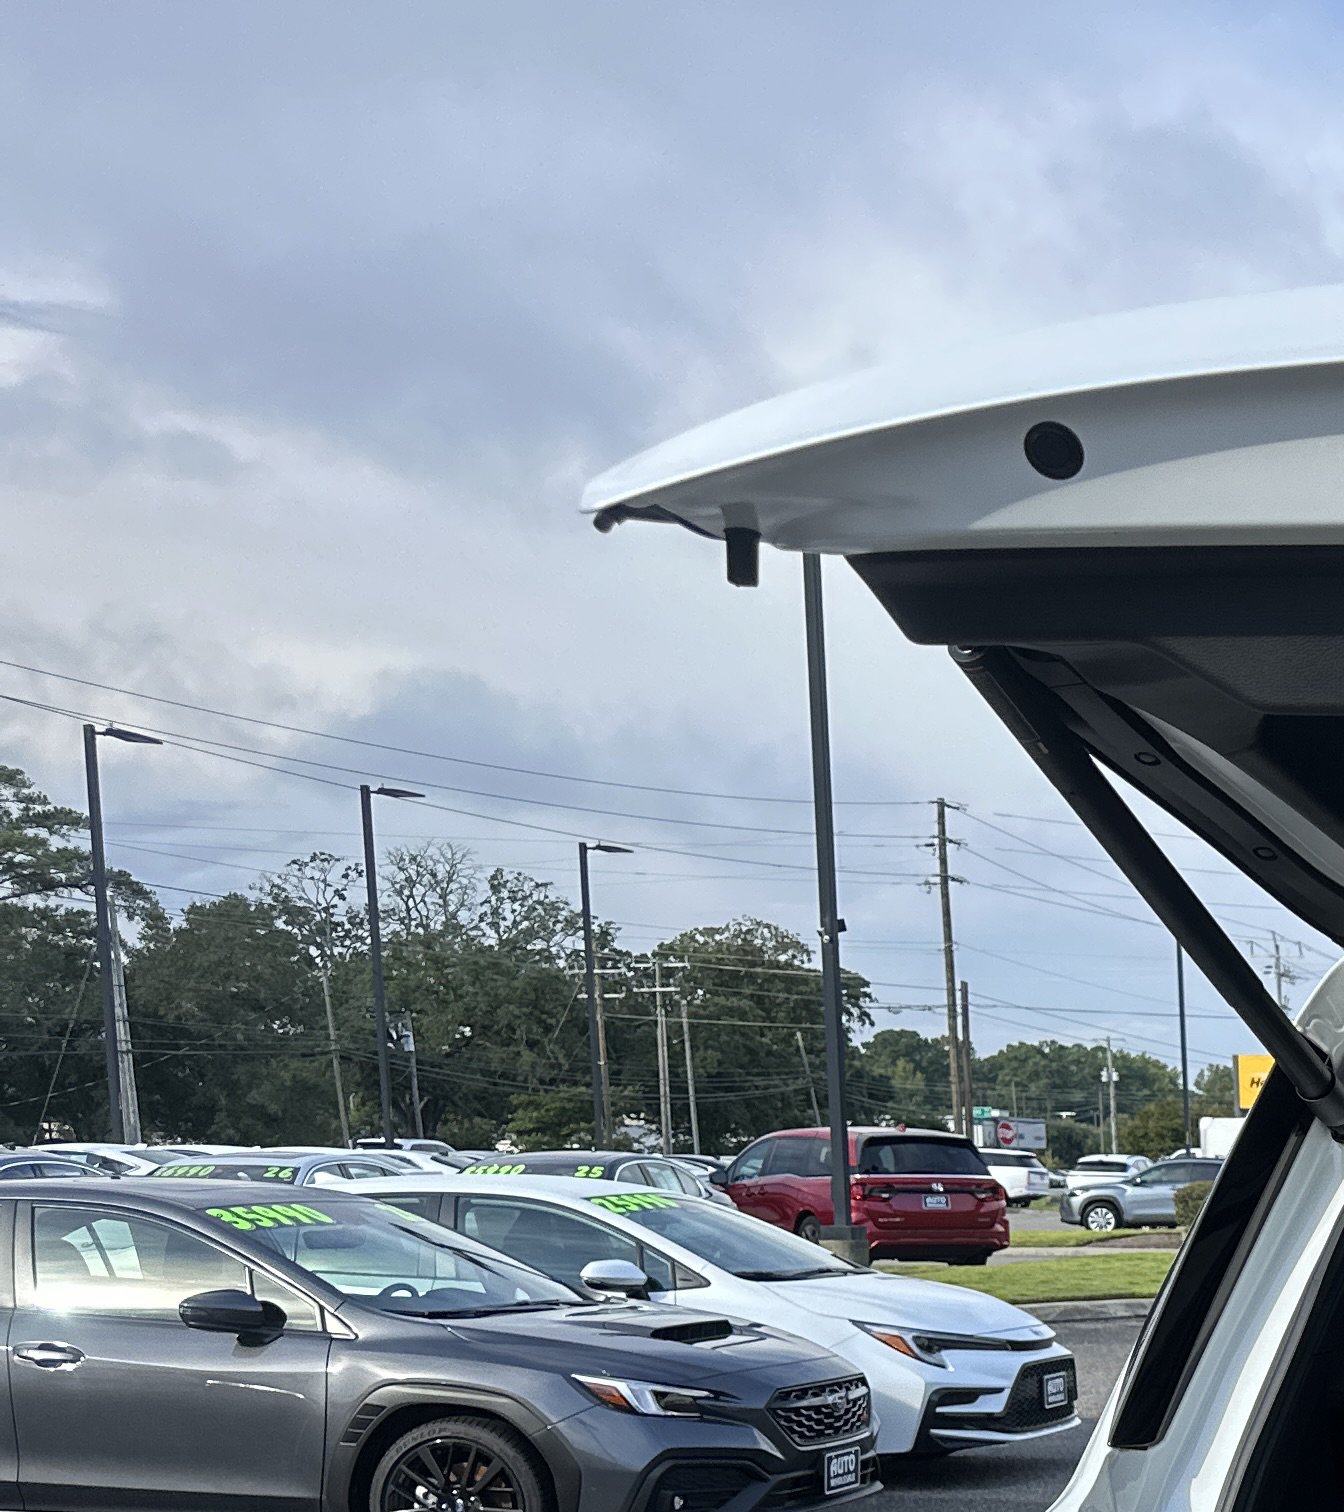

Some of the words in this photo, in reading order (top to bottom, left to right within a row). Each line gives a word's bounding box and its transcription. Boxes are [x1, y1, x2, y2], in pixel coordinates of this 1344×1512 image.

[263, 1167, 294, 1178] 26
[574, 1166, 605, 1178] 25
[205, 1203, 336, 1231] 35990
[830, 1453, 856, 1478] AUTO
